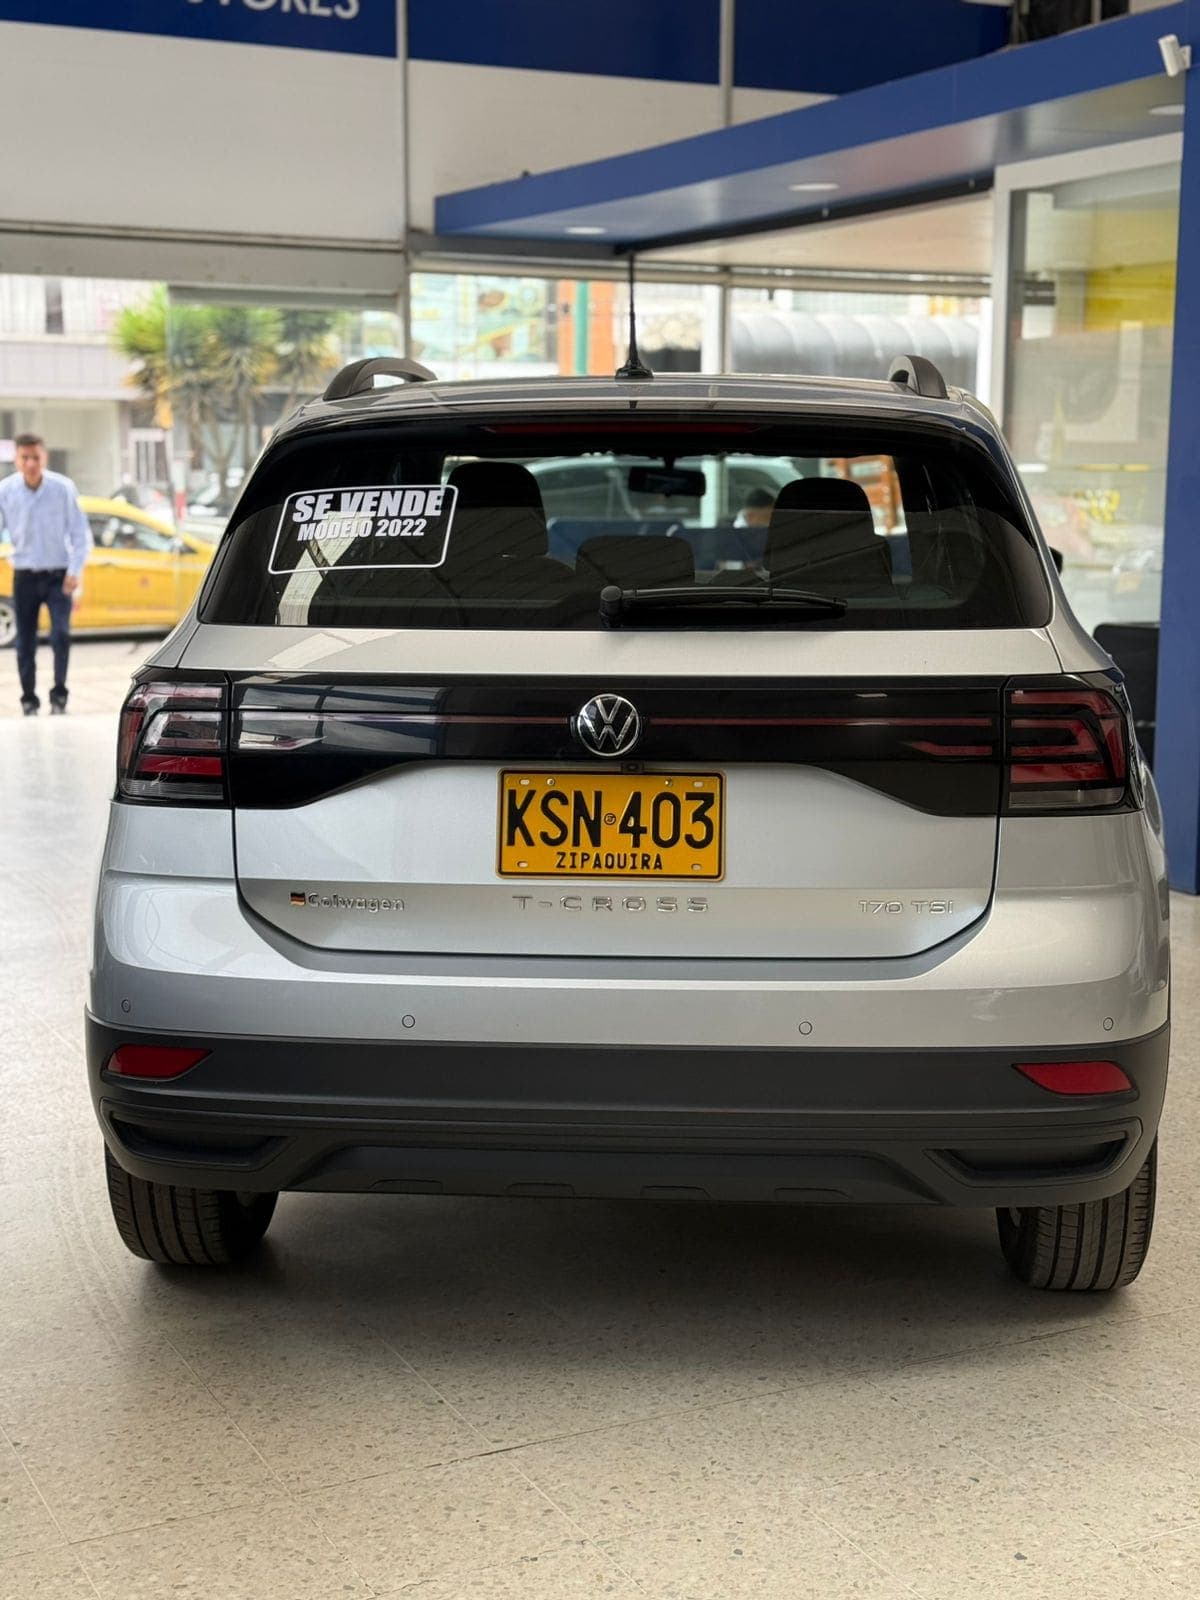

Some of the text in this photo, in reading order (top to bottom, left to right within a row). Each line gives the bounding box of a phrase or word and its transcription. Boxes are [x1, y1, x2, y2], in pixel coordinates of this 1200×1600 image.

[292, 490, 445, 523] SE VENDE
[297, 518, 427, 542] MODELO 2022
[506, 789, 715, 849] KSN 403
[555, 851, 663, 870] ZIPAQUIRA
[308, 892, 405, 913] Colwagen
[511, 895, 709, 912] T-CROSS
[858, 900, 954, 914] 170 TSI
